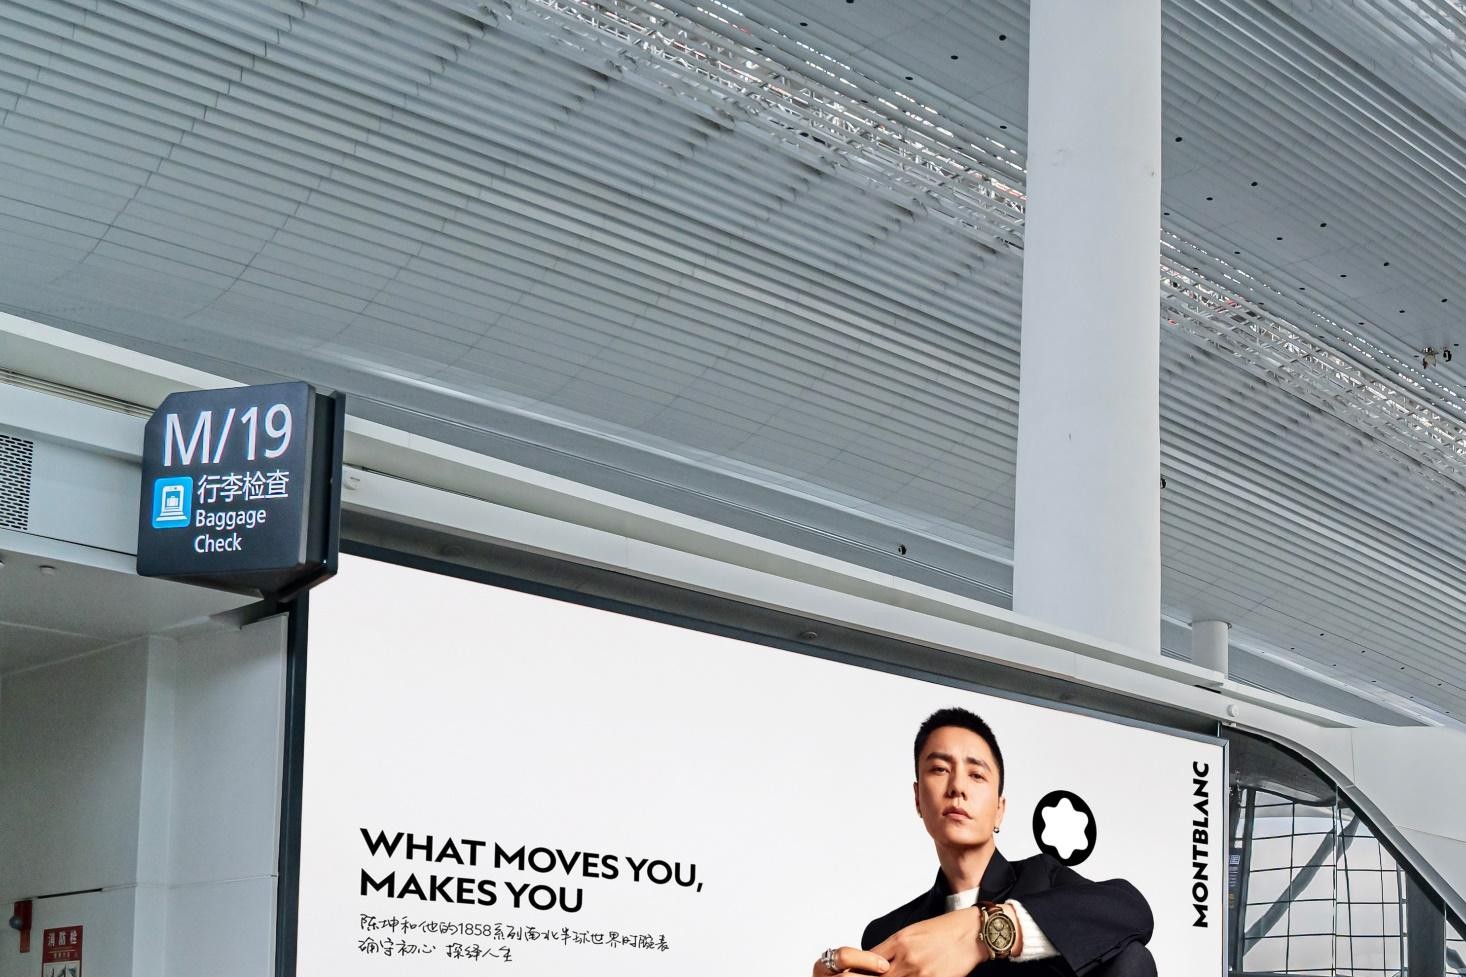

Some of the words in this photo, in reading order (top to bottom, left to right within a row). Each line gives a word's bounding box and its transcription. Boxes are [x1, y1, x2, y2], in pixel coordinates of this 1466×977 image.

[163, 404, 293, 467] M/19
[197, 470, 290, 505] 行李检查
[195, 508, 267, 531] Baggage
[194, 534, 243, 553] Check
[360, 827, 486, 866] WHAT
[494, 842, 619, 880] MOVES
[625, 856, 703, 893] YOU,
[1192, 761, 1209, 928] MONTBLANC
[360, 868, 497, 906] MAKES
[504, 881, 583, 913] YOU
